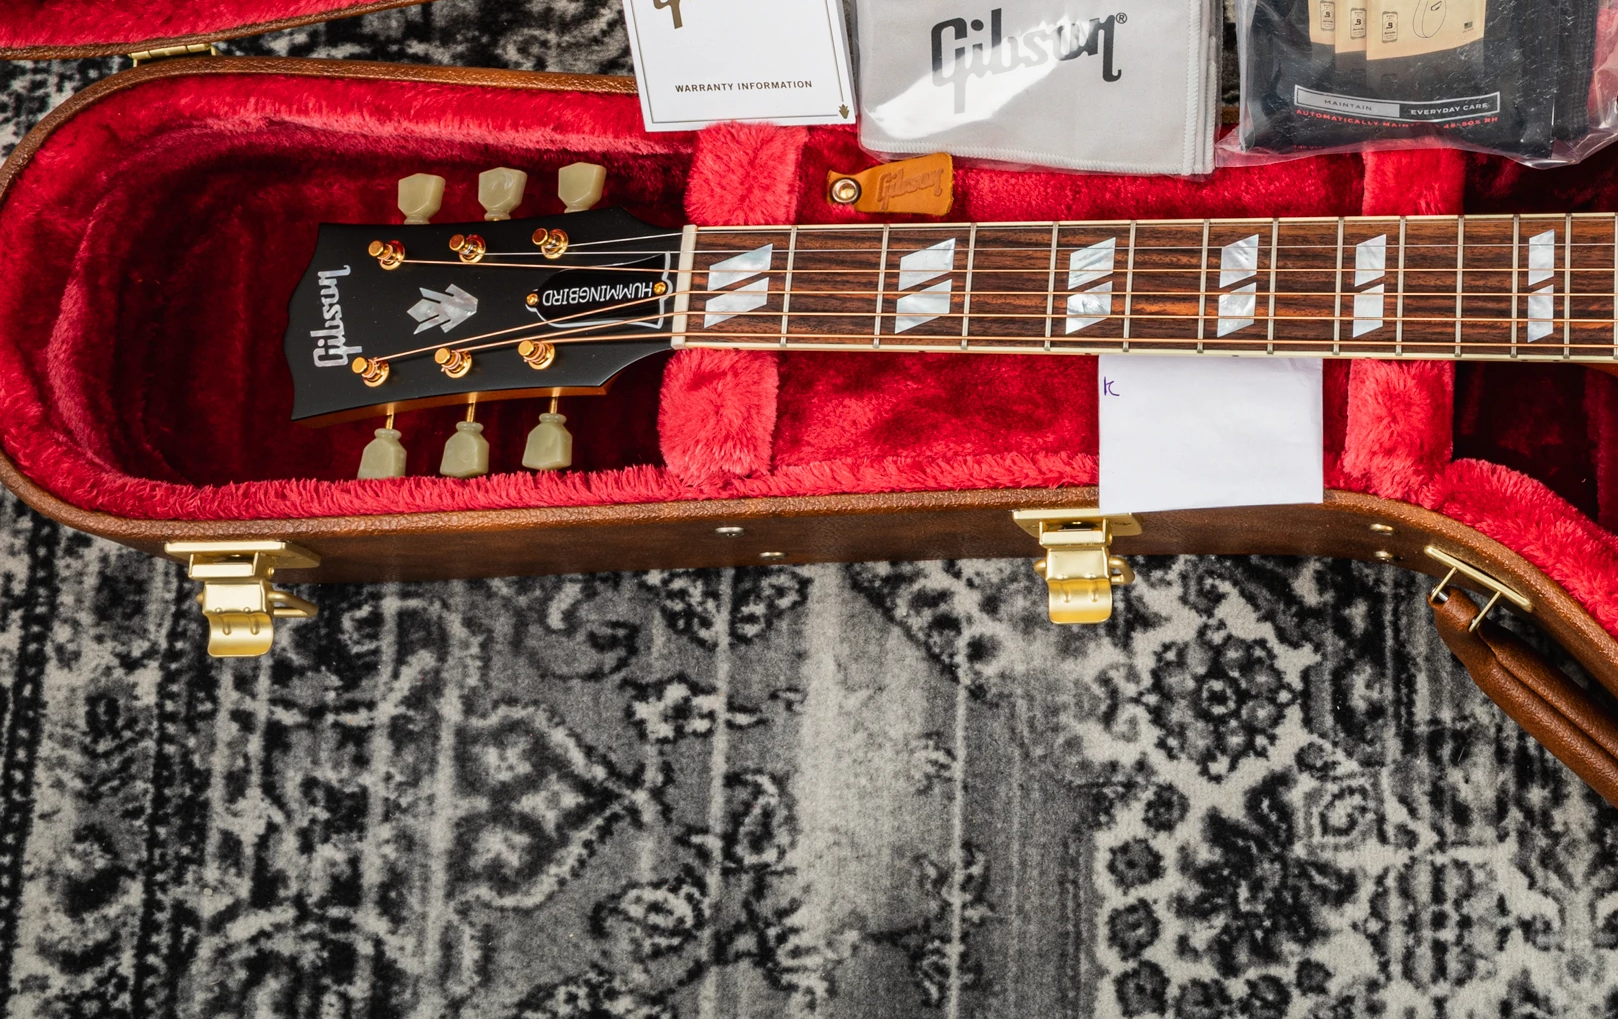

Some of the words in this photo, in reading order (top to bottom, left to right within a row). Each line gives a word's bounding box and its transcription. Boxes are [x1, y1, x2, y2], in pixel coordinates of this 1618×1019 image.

[675, 82, 734, 93] WARRANTY
[737, 80, 813, 91] INFORMATION
[1324, 99, 1373, 111] MAINTAIN
[1410, 106, 1460, 116] EVERYDAY
[1296, 109, 1379, 127] AUTOMATICALLY
[542, 281, 653, 307] HUMMINGBIRD
[310, 265, 362, 367] Gibson
